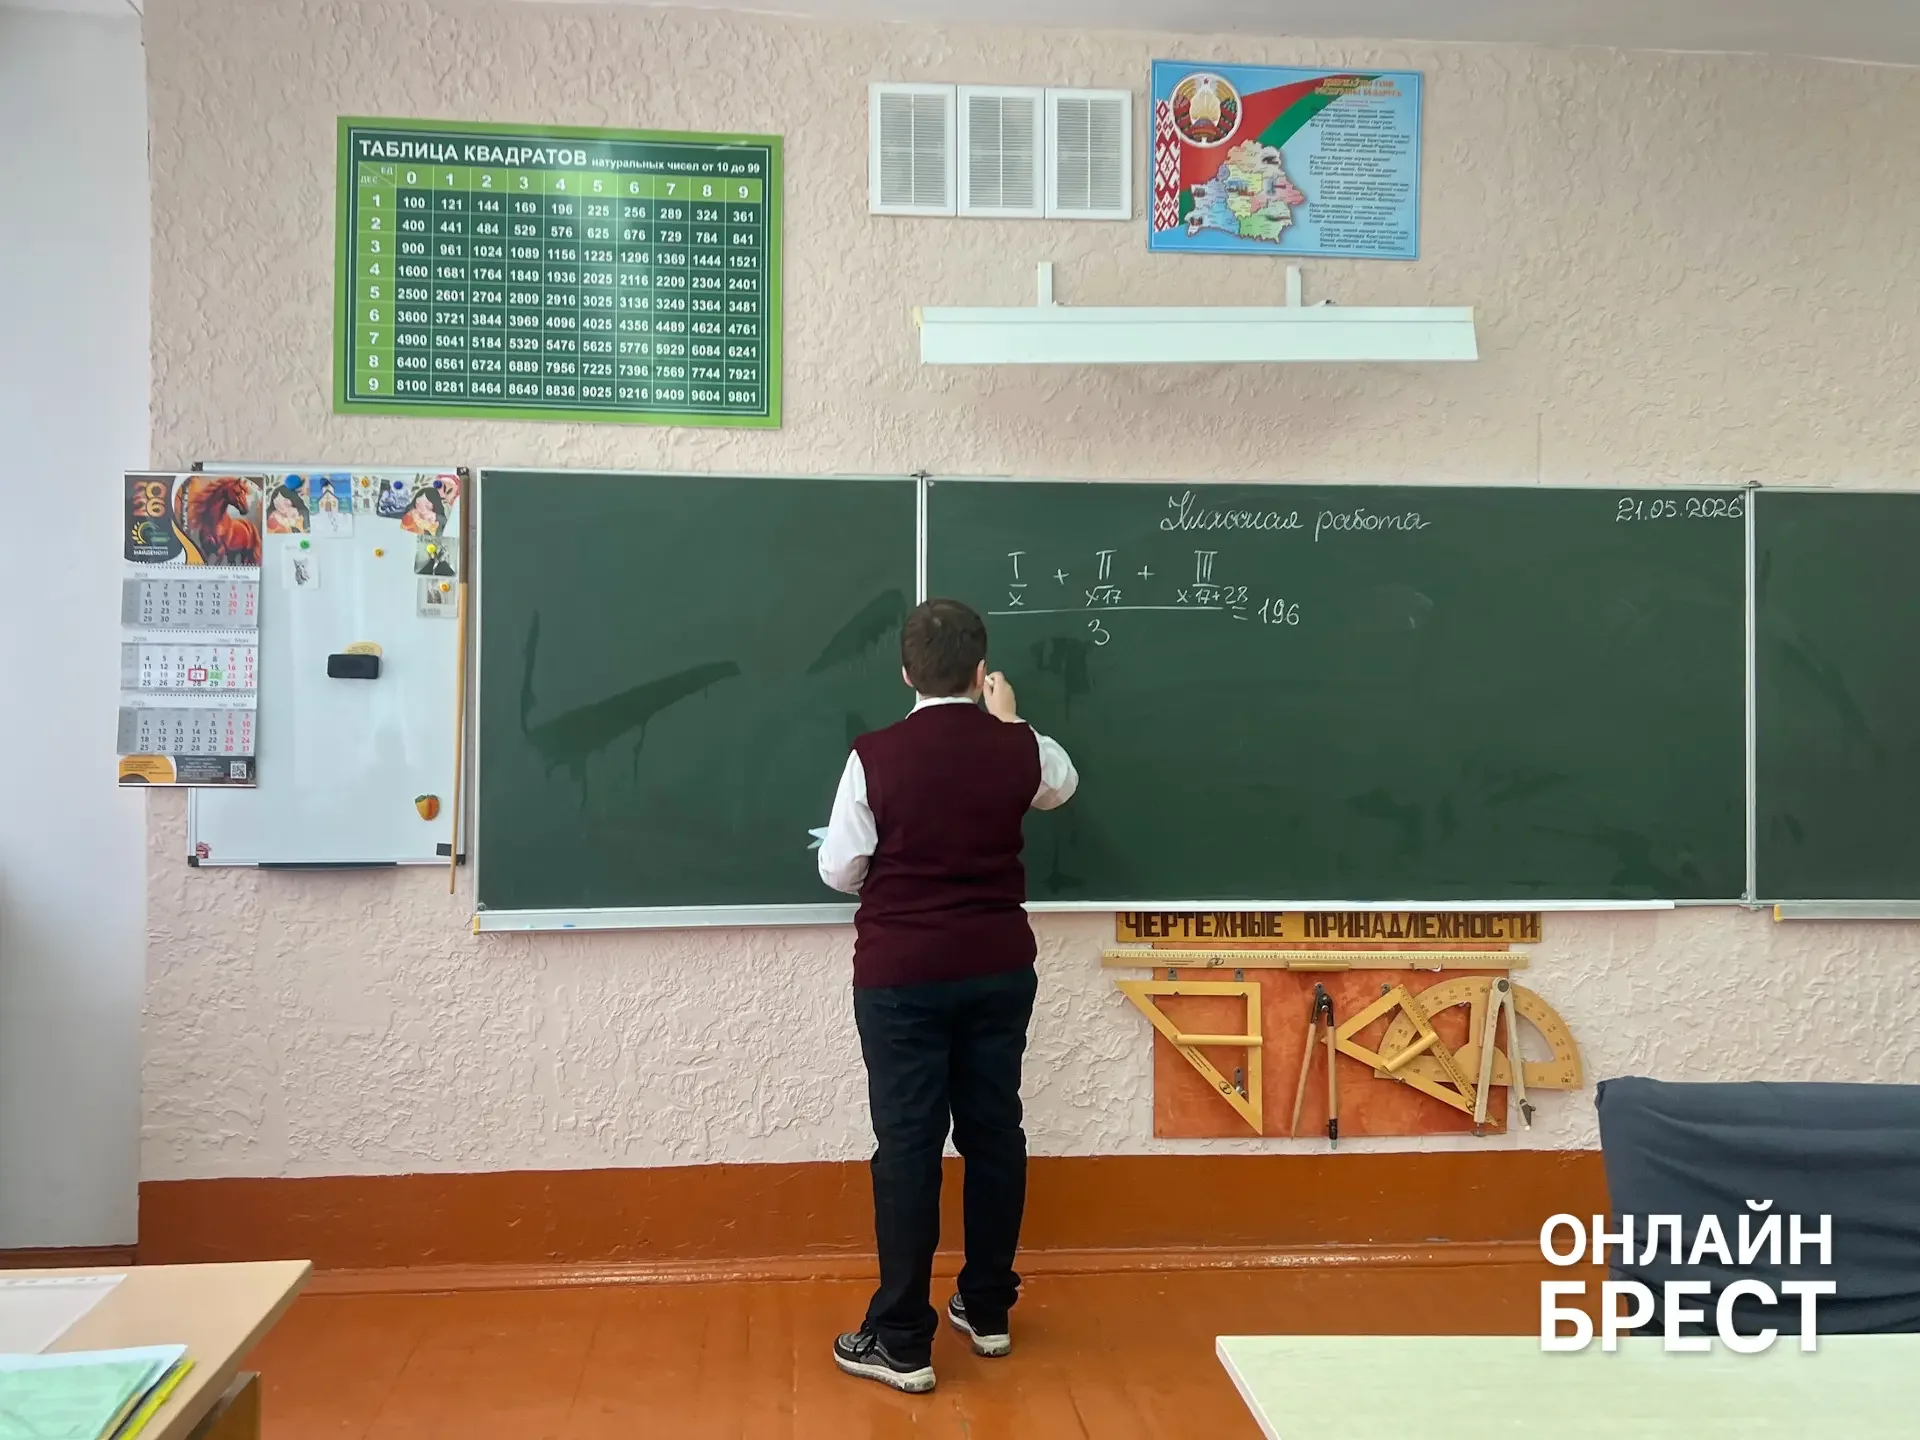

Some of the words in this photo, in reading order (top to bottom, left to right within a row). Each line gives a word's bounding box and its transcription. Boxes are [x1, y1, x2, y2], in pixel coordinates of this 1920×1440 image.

[358, 140, 458, 162] ТАБЛИЦА
[464, 145, 587, 166] КВАДРАТОВ
[592, 157, 664, 170] натуральных
[667, 160, 700, 171] чисел
[702, 164, 714, 172] от
[717, 162, 728, 172] 10
[731, 164, 744, 174] до
[748, 163, 760, 173] 99
[407, 171, 416, 184] 0
[446, 173, 453, 186] 1
[482, 175, 492, 188] 2
[520, 176, 528, 189] 3
[556, 178, 566, 190] 4
[593, 180, 602, 192] 5
[630, 182, 639, 194] 6
[666, 183, 676, 195] 7
[702, 184, 712, 197] 8
[739, 186, 748, 198] 9
[373, 194, 380, 207] 1
[404, 197, 425, 208] 100
[442, 199, 462, 210] 121
[478, 200, 499, 212] 144
[515, 202, 536, 213] 169
[552, 203, 573, 215] 196
[588, 205, 609, 216] 225
[624, 206, 645, 218] 256
[660, 208, 682, 219] 289
[696, 210, 718, 221] 324
[733, 211, 753, 222] 361
[371, 217, 380, 230] 2
[402, 219, 425, 231] 400
[440, 221, 461, 233] 441
[477, 223, 499, 234] 484
[514, 224, 536, 236] 529
[551, 226, 573, 238] 576
[587, 228, 609, 239] 625
[623, 229, 645, 240] 676
[660, 230, 681, 242] 729
[696, 232, 717, 244] 784
[733, 233, 753, 245] 841
[371, 240, 380, 253] 3
[402, 242, 424, 254] 900
[440, 244, 461, 256] 961
[474, 246, 502, 257] 1024
[511, 247, 539, 259] 1089
[548, 248, 576, 260] 1156
[584, 250, 613, 262] 1225
[621, 252, 649, 263] 1296
[657, 253, 684, 265] 1369
[693, 254, 721, 266] 1444
[730, 256, 756, 268] 1521
[370, 263, 380, 275] 4
[399, 265, 428, 277] 1600
[437, 267, 464, 279] 1681
[473, 268, 502, 280] 1764
[510, 270, 539, 282] 1849
[547, 271, 576, 283] 1936
[583, 273, 612, 284] 2025
[620, 274, 648, 286] 2116
[656, 276, 685, 287] 2209
[692, 277, 721, 289] 2304
[729, 278, 756, 290] 2401
[370, 286, 380, 299] 5
[398, 288, 428, 300] 2500
[436, 290, 464, 302] 2601
[472, 291, 502, 303] 2704
[510, 293, 539, 304] 2809
[546, 294, 576, 306] 2916
[583, 295, 612, 307] 3025
[619, 297, 648, 308] 3136
[656, 298, 685, 310] 3249
[692, 300, 721, 311] 3364
[729, 301, 756, 312] 3481
[369, 309, 380, 321] 6
[398, 311, 427, 323] 3600
[436, 312, 464, 324] 3721
[472, 314, 502, 326] 3844
[510, 315, 539, 327] 3969
[546, 317, 575, 328] 4096
[583, 318, 612, 330] 4025
[619, 319, 648, 331] 4356
[655, 321, 684, 332] 4489
[692, 322, 720, 334] 4624
[728, 324, 756, 335] 4761
[369, 332, 379, 344] 7
[397, 334, 427, 346] 4900
[436, 335, 464, 347] 5041
[472, 336, 501, 348] 5184
[509, 338, 538, 350] 5329
[546, 339, 575, 351] 5476
[583, 341, 612, 352] 5625
[620, 342, 648, 354] 5776
[656, 343, 684, 355] 5929
[692, 345, 721, 356] 6084
[728, 346, 756, 358] 6241
[369, 355, 379, 367] 8
[397, 357, 427, 368] 6400
[435, 358, 464, 370] 6561
[472, 359, 501, 371] 6724
[509, 360, 538, 372] 6889
[582, 363, 611, 375] 7225
[619, 365, 648, 376] 7396
[656, 366, 684, 378] 7569
[693, 367, 720, 379] 7744
[729, 368, 756, 380] 7921
[368, 378, 379, 391] 9
[397, 380, 427, 391] 8100
[435, 381, 464, 393] 8281
[472, 382, 501, 394] 8464
[509, 383, 538, 395] 8649
[545, 385, 575, 396] 8836
[582, 386, 612, 398] 9025
[618, 387, 648, 399] 9216
[655, 388, 683, 400] 9409
[692, 390, 720, 401] 9604
[728, 391, 756, 402] 9801
[1616, 497, 1744, 522] 21.05.2026
[1315, 508, 1432, 542] работа
[1258, 598, 1300, 626] 196
[1088, 618, 1110, 646] 3
[1125, 912, 1283, 938] ЧЕРТЕЖНЫЕ
[1304, 911, 1538, 938] ПРИНАДЛЕЖНОСТИ
